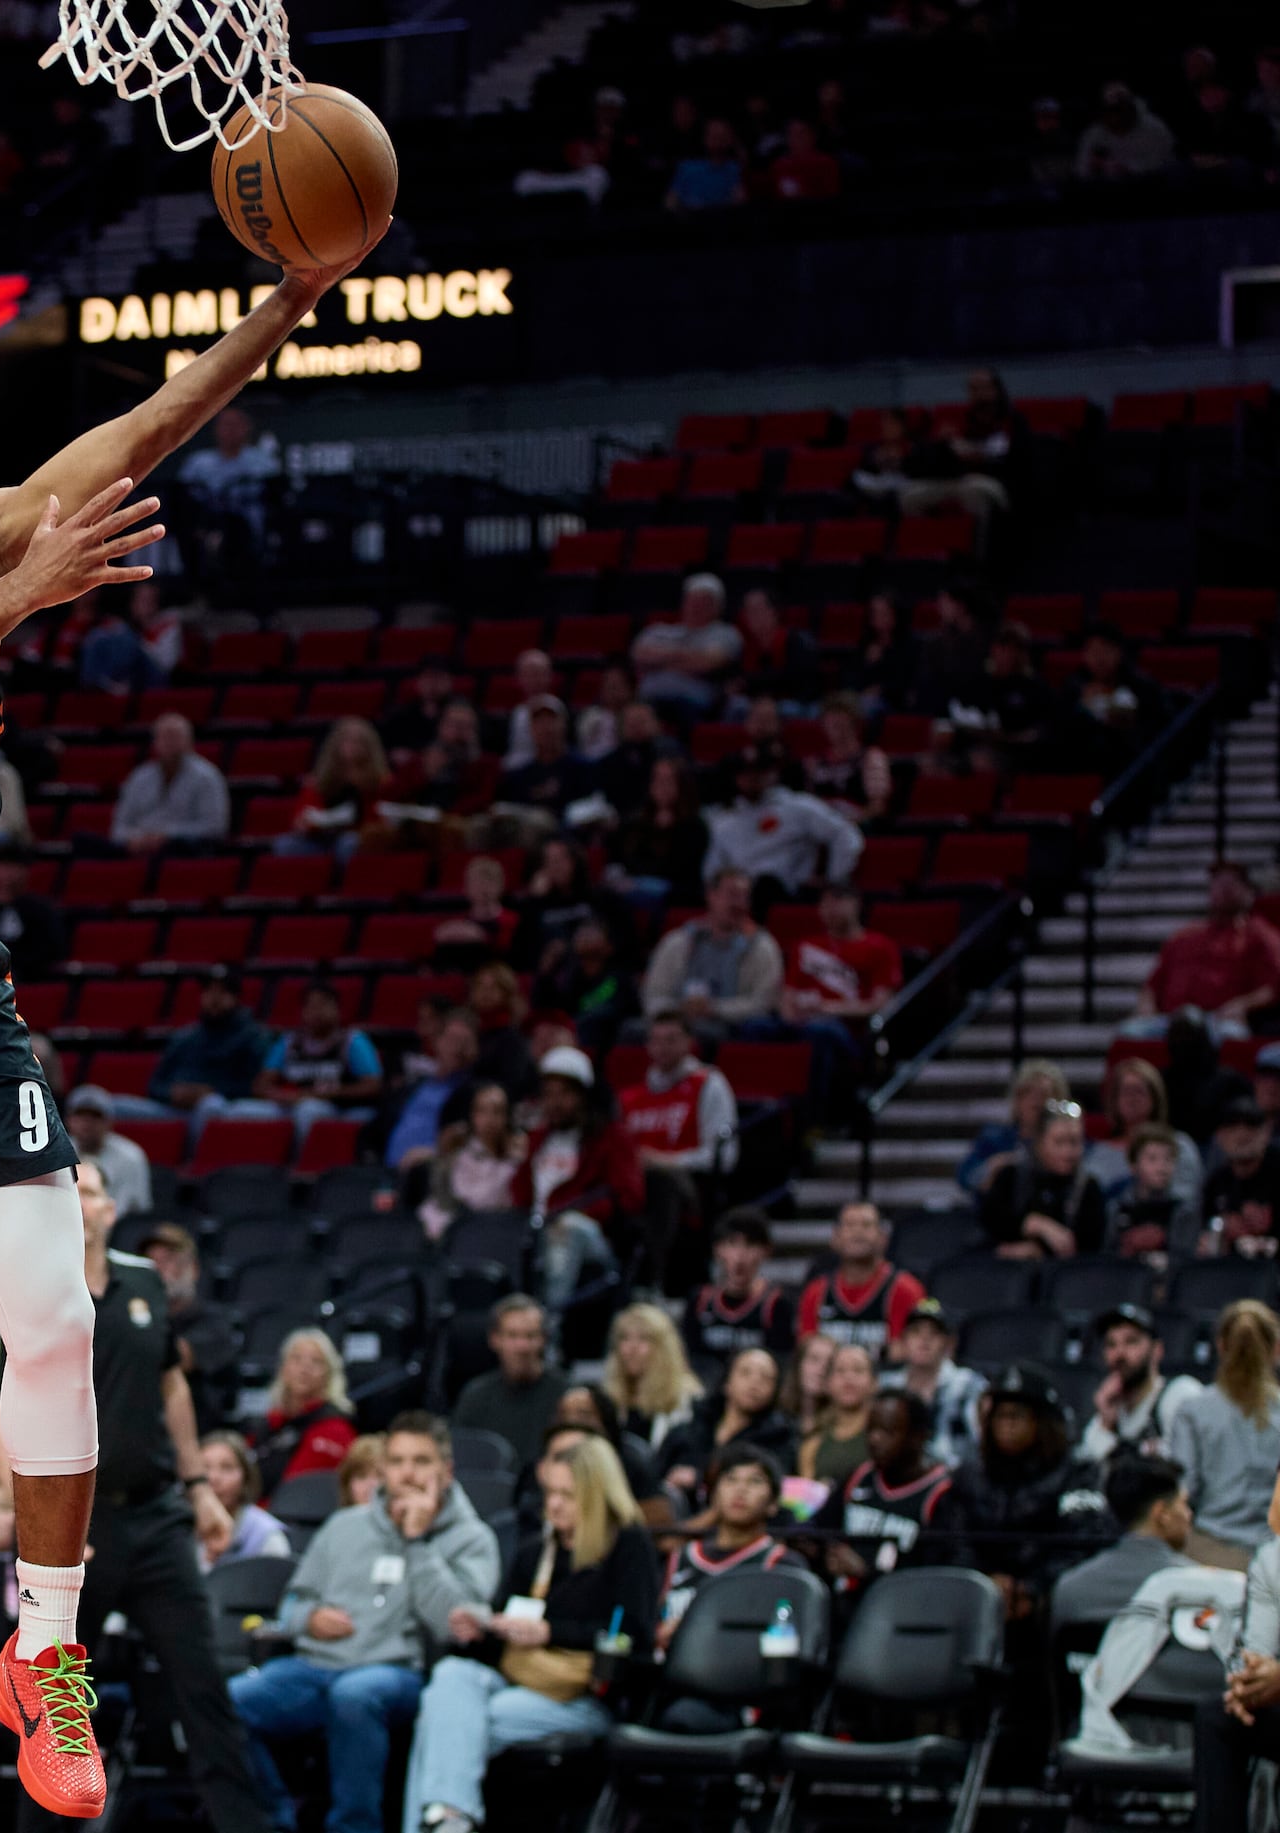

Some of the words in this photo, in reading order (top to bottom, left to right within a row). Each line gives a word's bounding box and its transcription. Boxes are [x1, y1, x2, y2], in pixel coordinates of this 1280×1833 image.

[235, 161, 291, 264] Wilson
[80, 283, 317, 343] DAIML
[340, 268, 513, 325] TRUCK
[276, 335, 420, 380] America
[19, 1080, 49, 1152] 9
